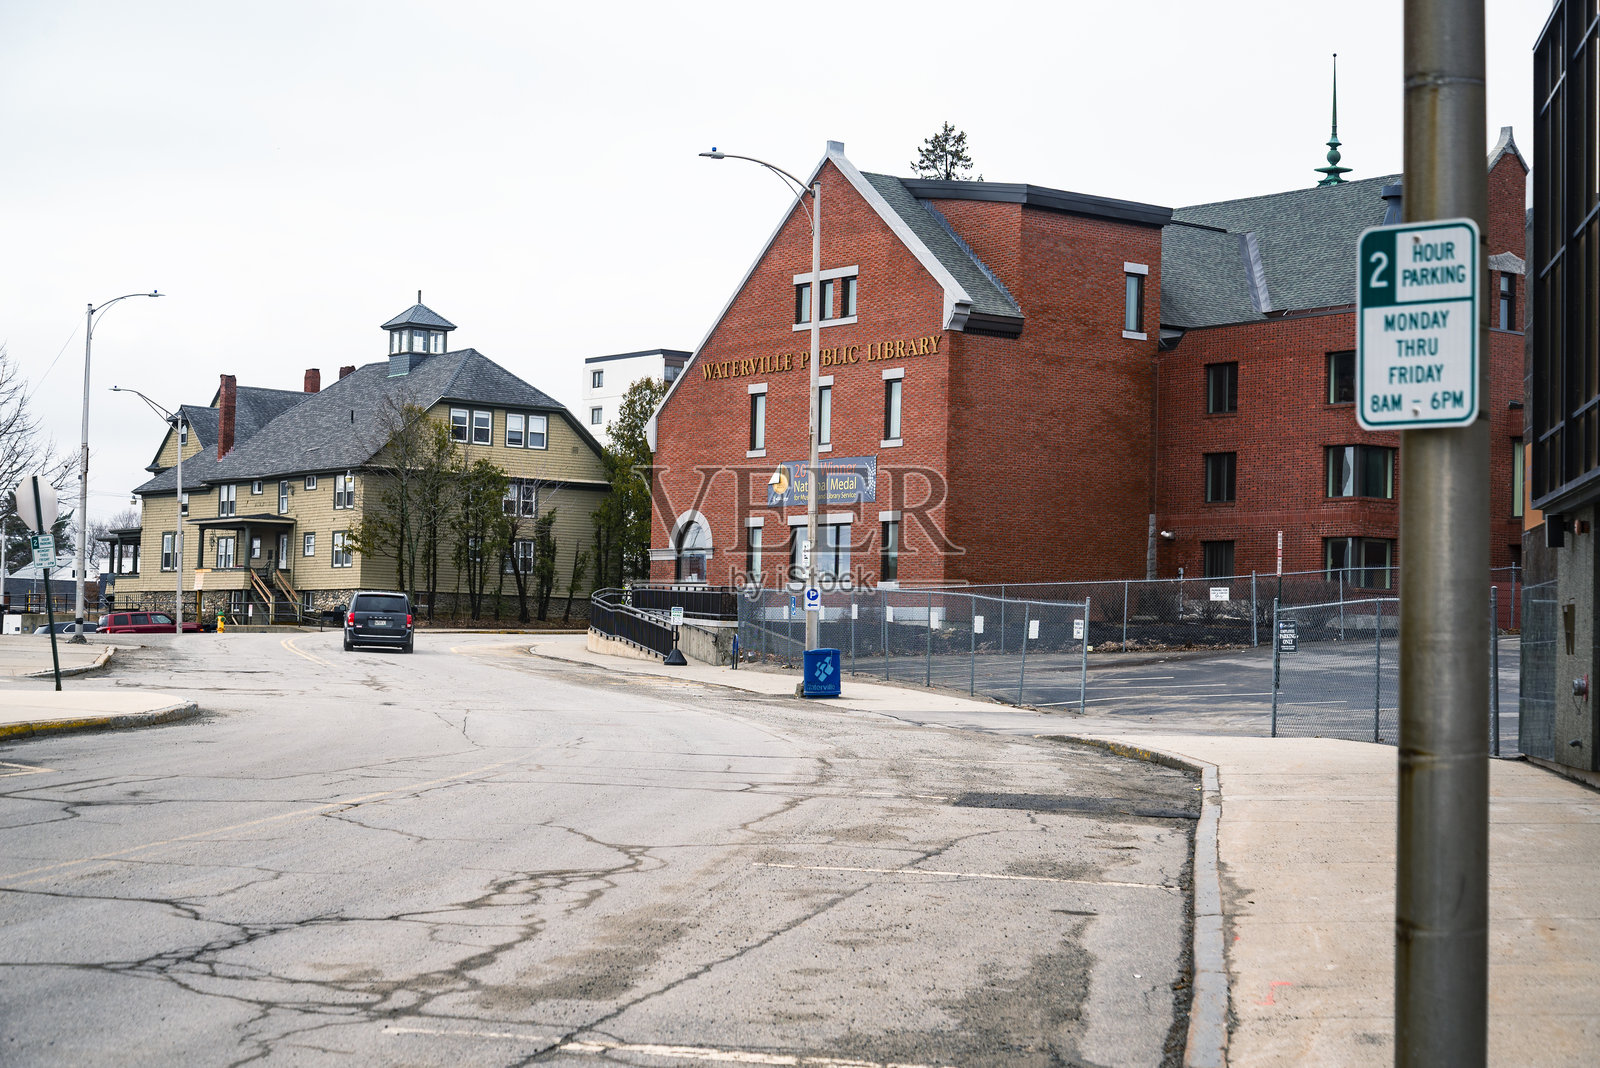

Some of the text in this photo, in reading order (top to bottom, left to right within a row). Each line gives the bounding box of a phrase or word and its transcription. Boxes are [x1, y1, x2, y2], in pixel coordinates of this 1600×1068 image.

[1413, 242, 1455, 262] HOUR
[1370, 251, 1388, 288] 2
[1401, 264, 1466, 288] PARKING
[1384, 310, 1450, 333] MONDAY
[702, 335, 942, 381] WATERVILLE PBLIC LIBRARY
[1396, 338, 1439, 358] THRU
[1388, 364, 1444, 386] FRIDAY
[1370, 393, 1403, 413] 8AM
[1430, 390, 1464, 410] 6PM
[820, 461, 857, 476] Winner
[793, 476, 857, 492] Natnal Medal
